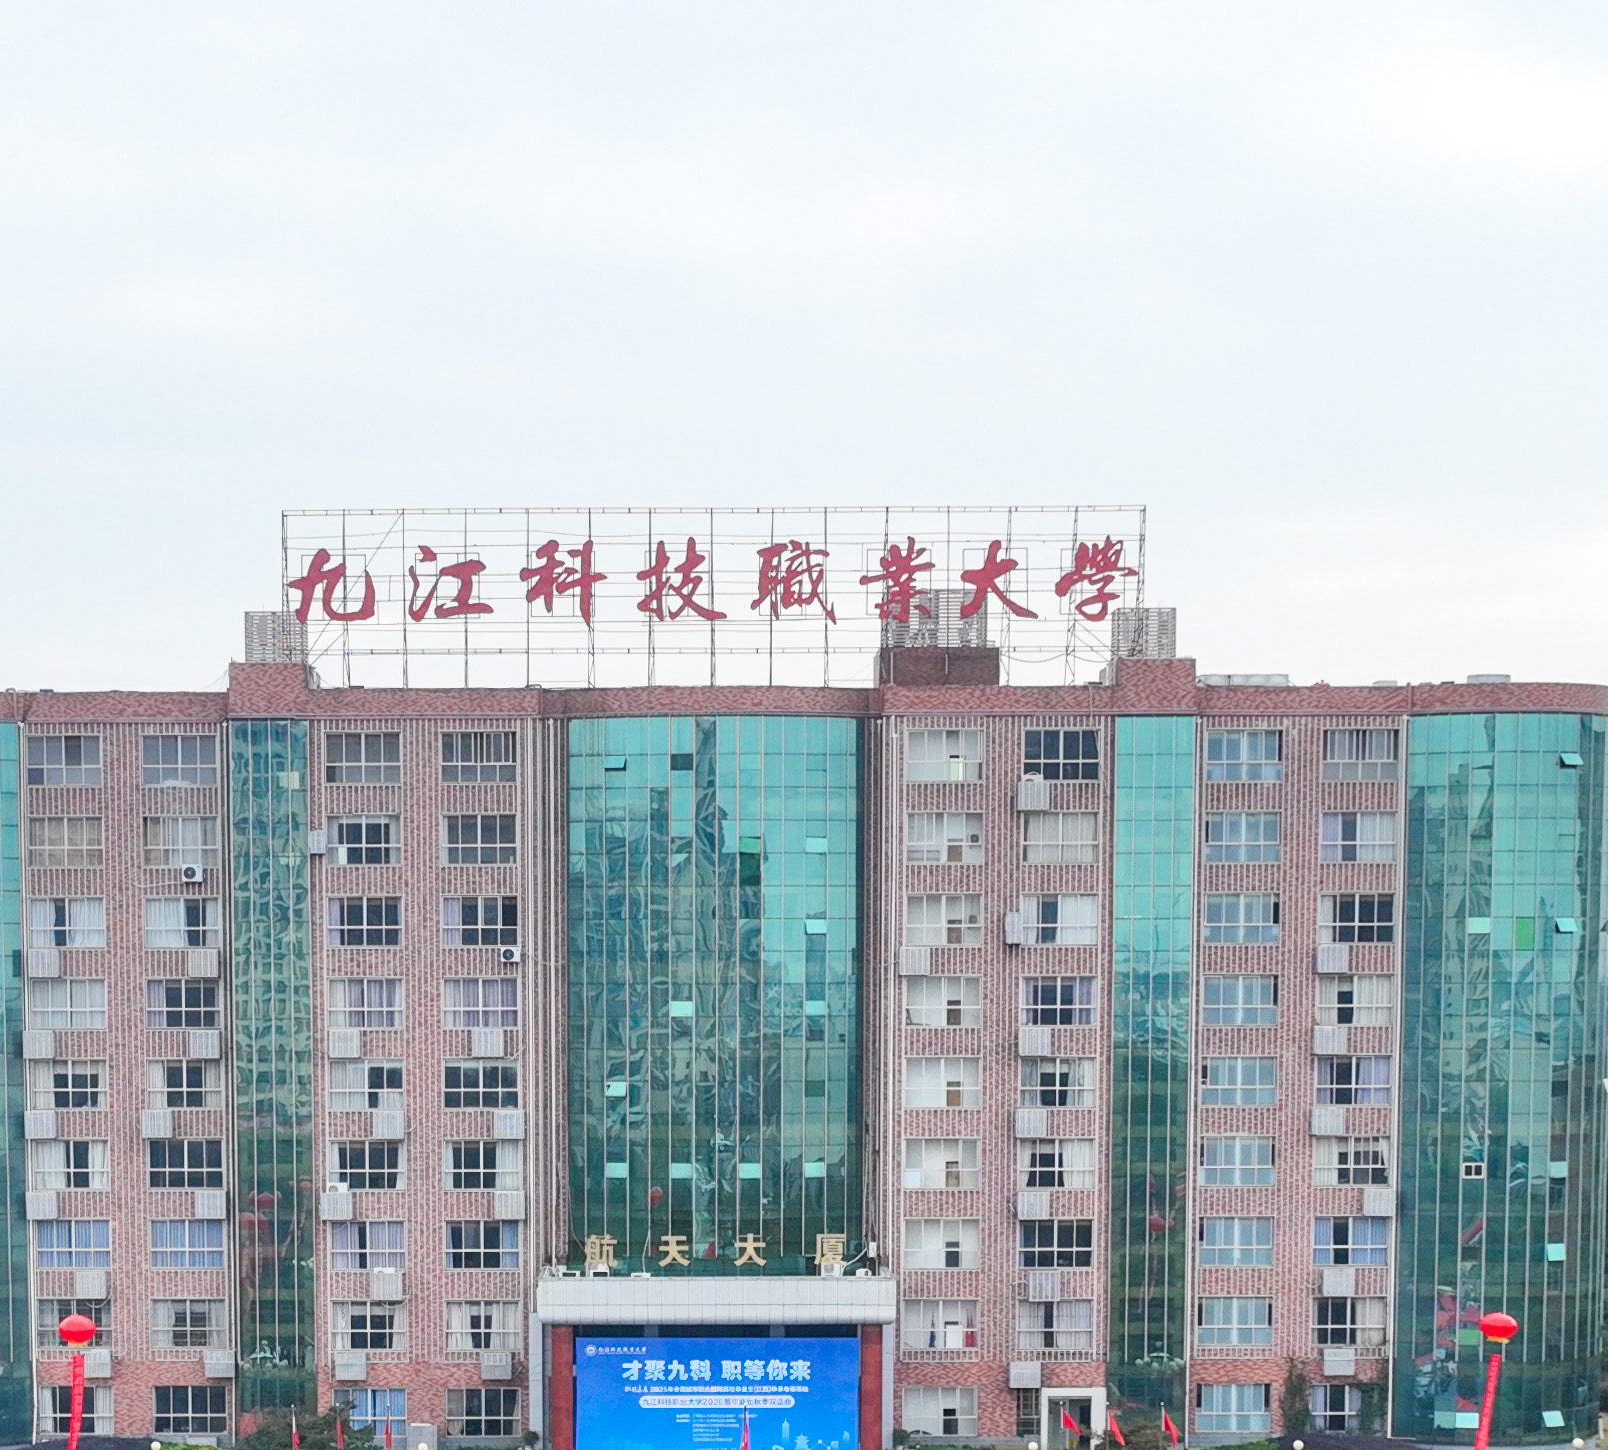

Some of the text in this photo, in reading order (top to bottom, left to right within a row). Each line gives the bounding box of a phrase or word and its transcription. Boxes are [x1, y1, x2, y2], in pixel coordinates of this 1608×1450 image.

[584, 1233, 847, 1267] 航天大厦
[622, 1359, 811, 1381] 才聚九科 职等你来
